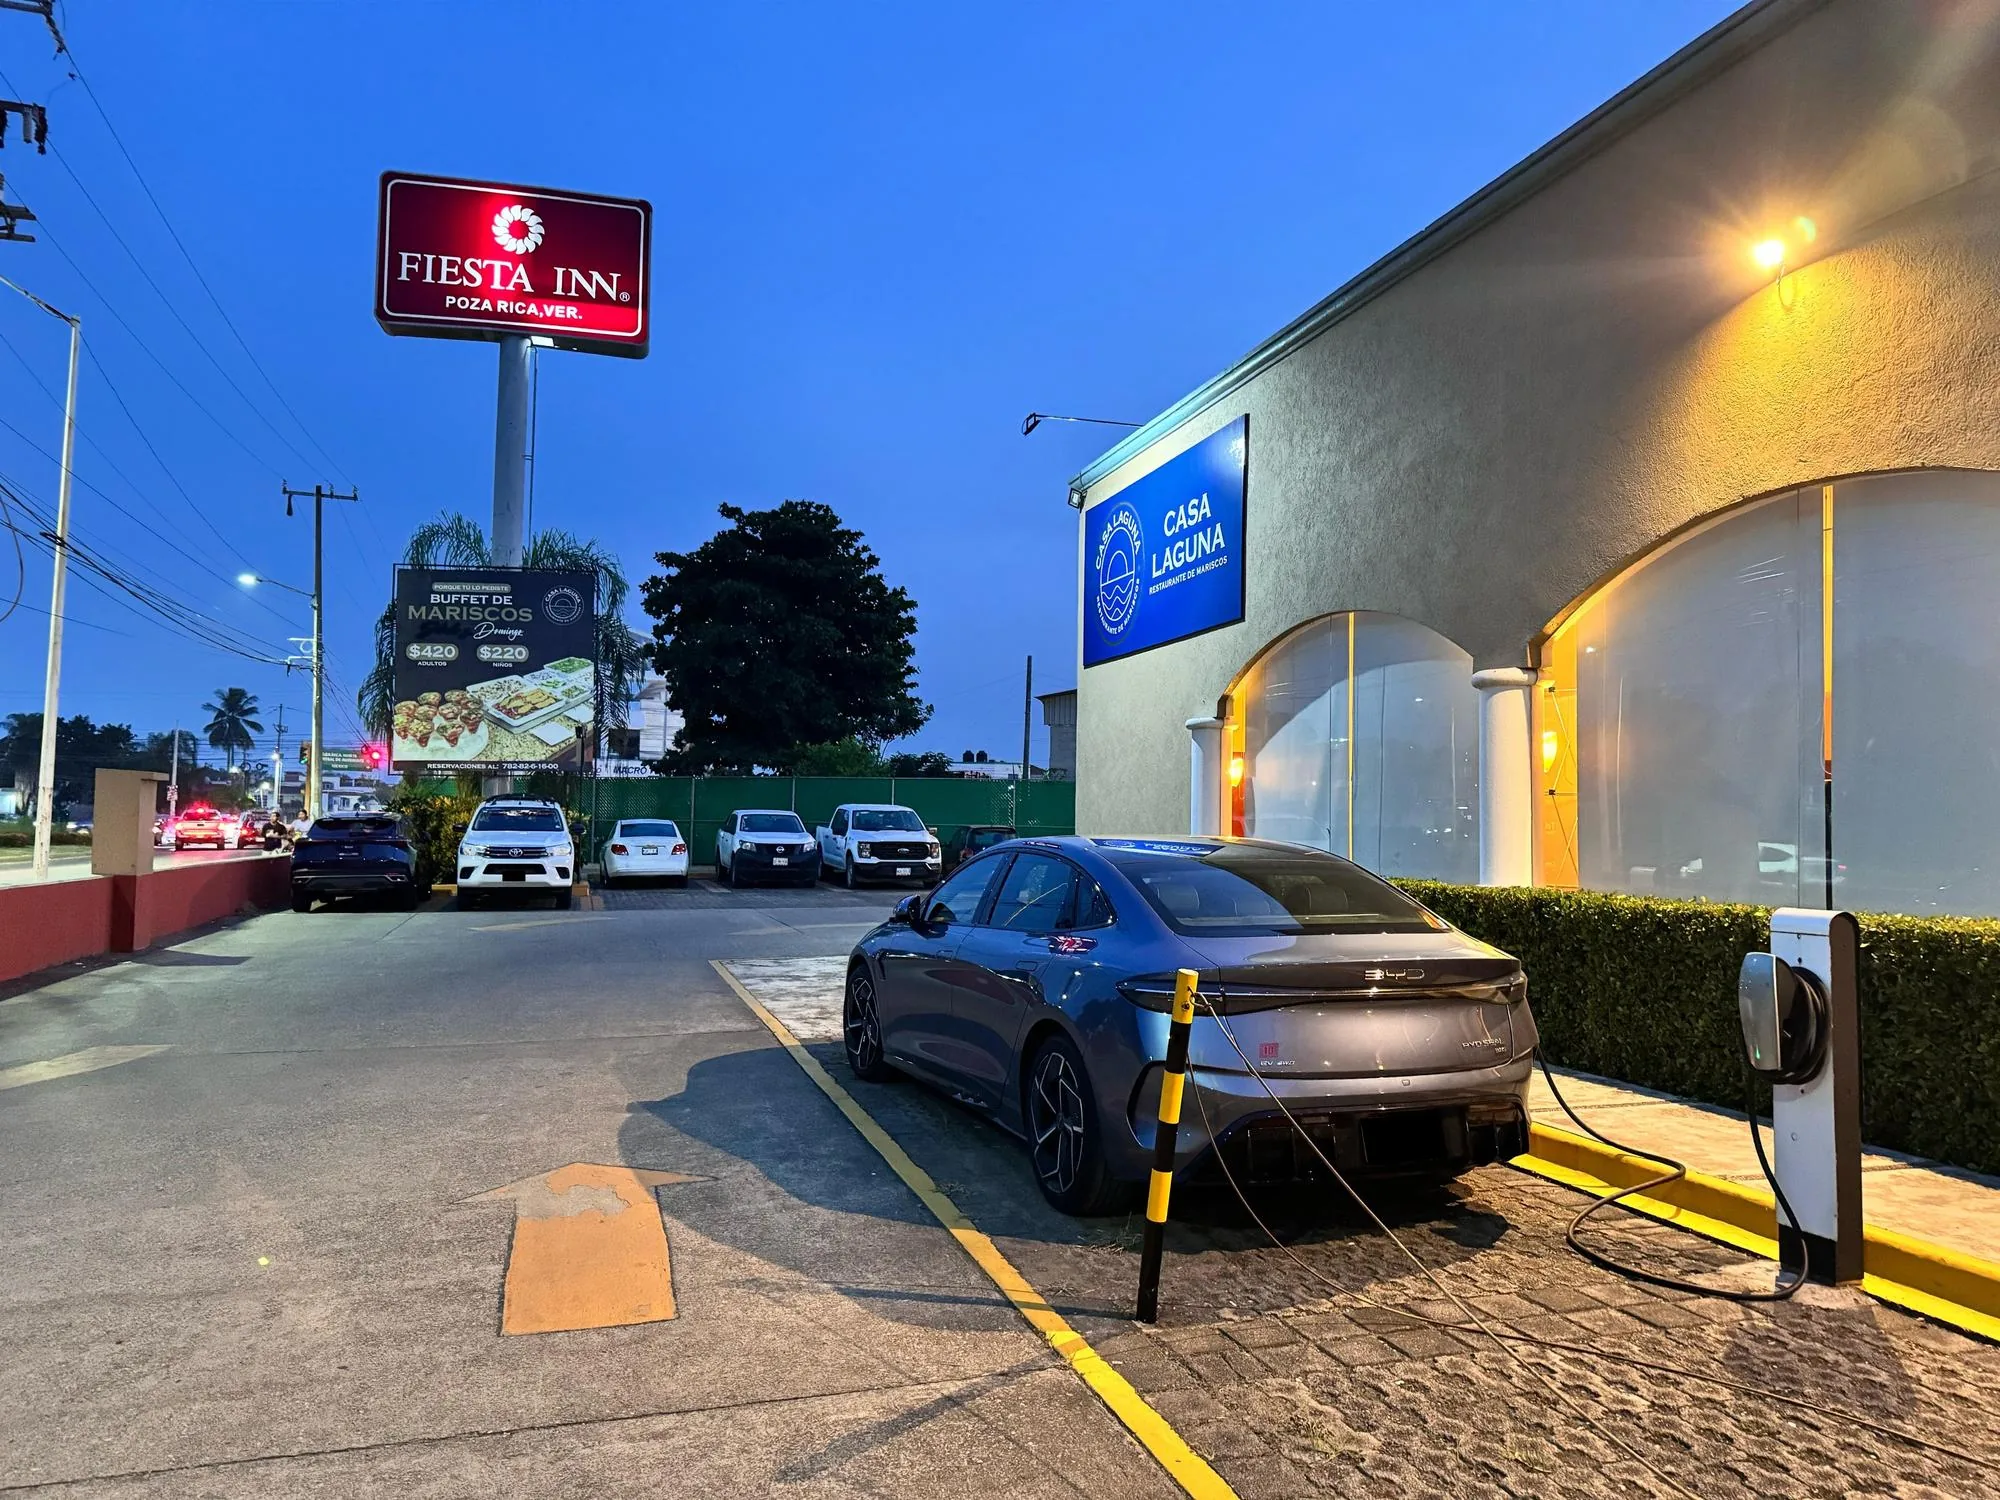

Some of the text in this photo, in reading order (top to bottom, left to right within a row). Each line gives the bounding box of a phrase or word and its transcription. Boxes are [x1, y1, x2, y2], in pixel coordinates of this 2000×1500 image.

[397, 252, 534, 292] FIESTA
[446, 295, 493, 312] POZA
[1163, 492, 1212, 537] CASA
[1096, 510, 1141, 570] CASA LAGUNA
[1152, 522, 1226, 579] LAGUNA
[1149, 555, 1228, 596] RESTAURANTE DE MARISCOS
[430, 594, 513, 605] BUFFET DE
[408, 605, 532, 622] MARISCOS
[409, 643, 456, 659] $420
[479, 645, 526, 660] $220
[1364, 968, 1425, 980] BYD
